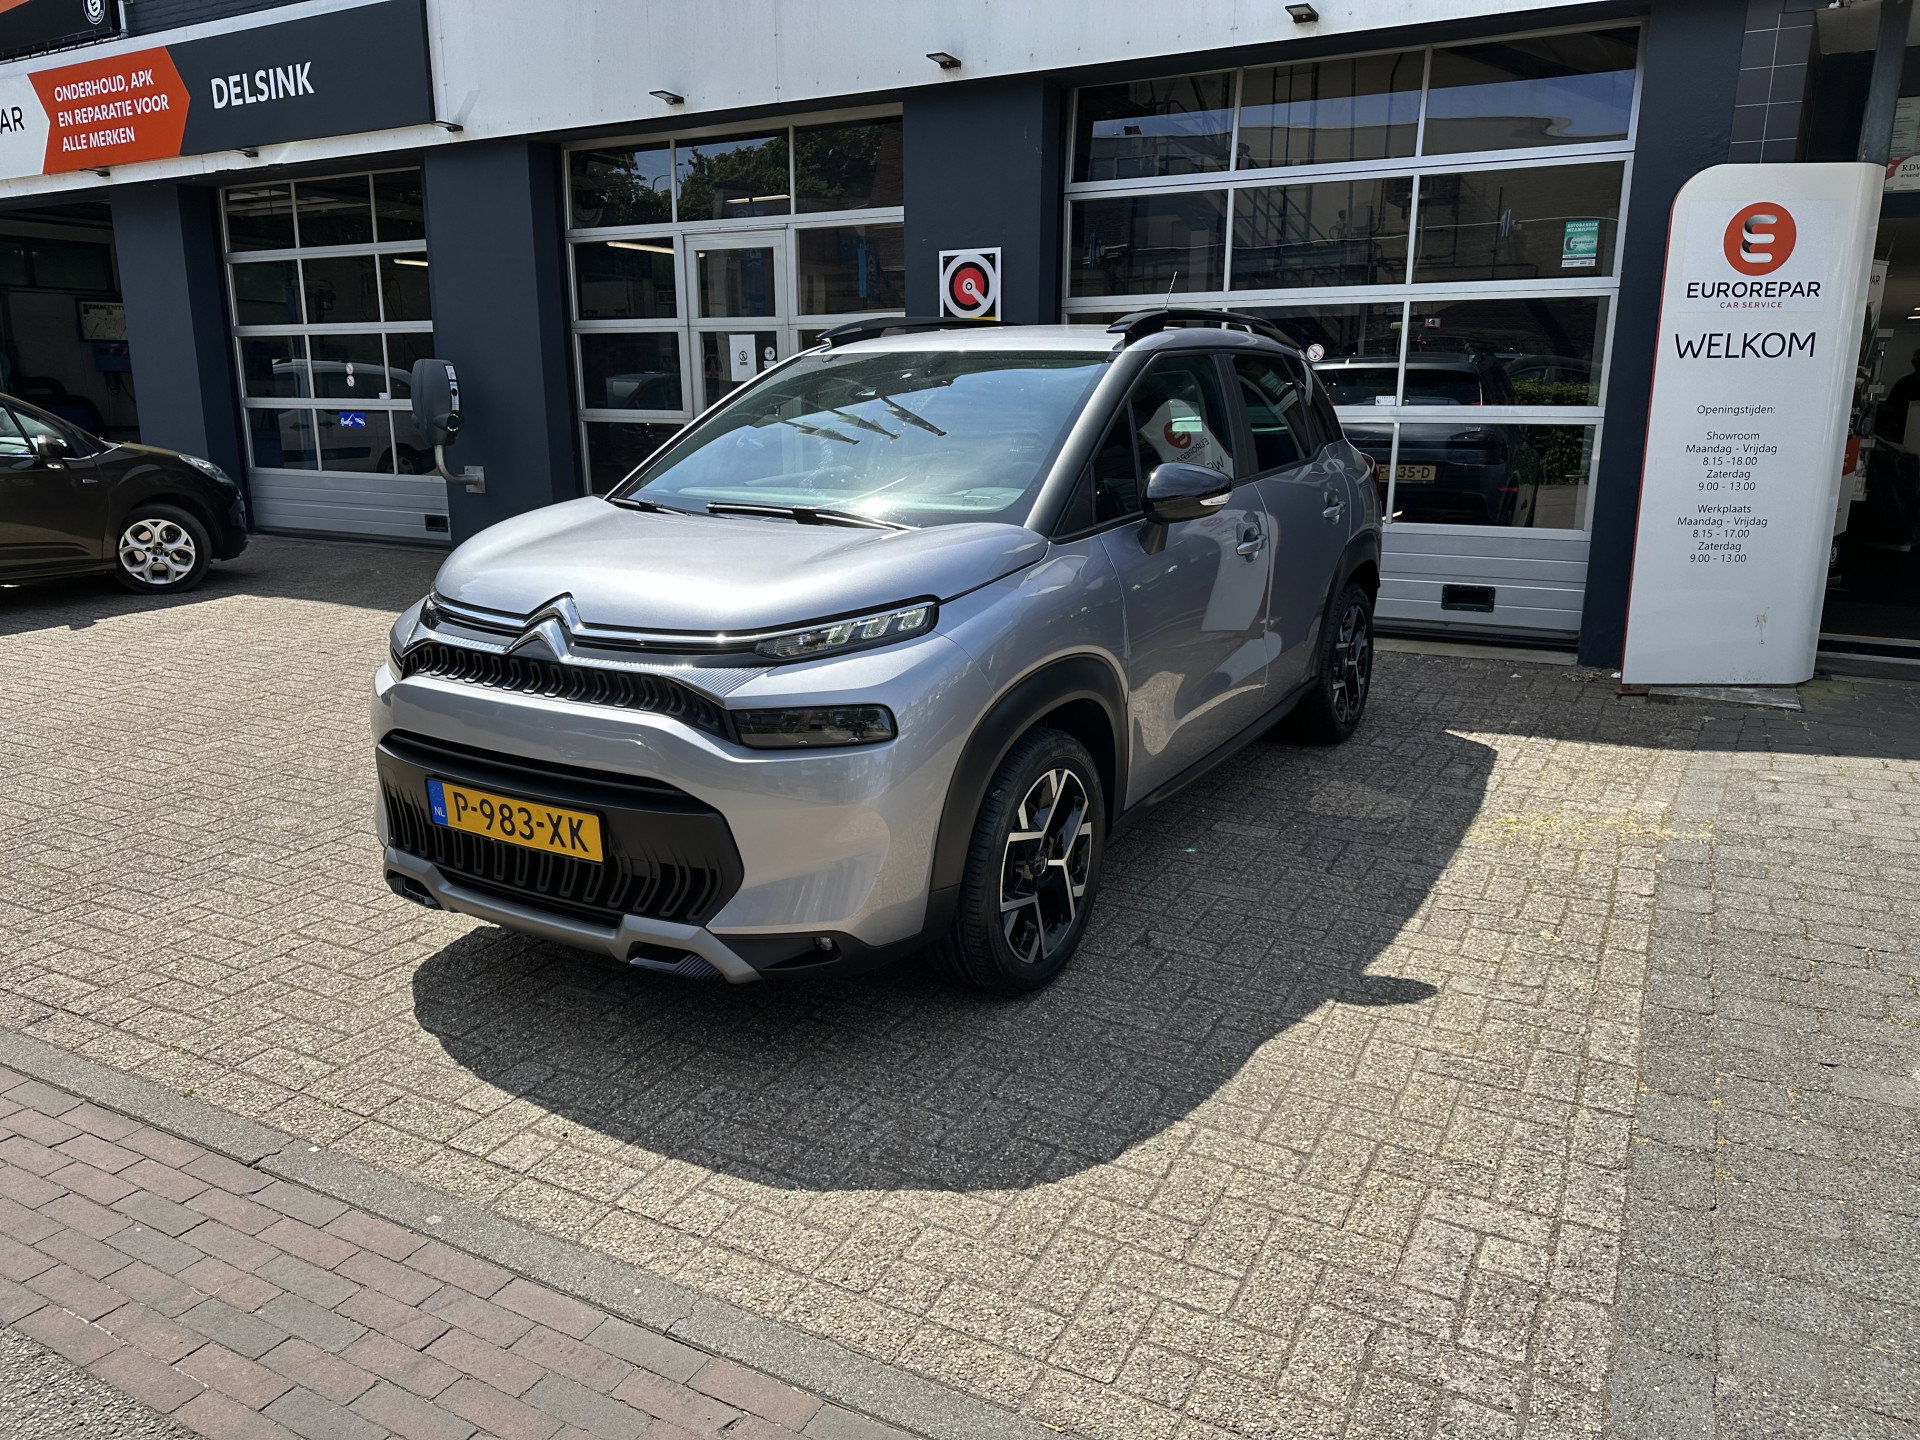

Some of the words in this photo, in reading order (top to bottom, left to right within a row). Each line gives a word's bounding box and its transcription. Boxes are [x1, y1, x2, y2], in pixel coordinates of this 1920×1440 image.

[55, 74, 129, 102] ONDERHOUD,
[130, 70, 154, 88] APK
[211, 62, 314, 108] DELSINK
[58, 110, 73, 127] EN
[75, 101, 134, 125] REPARATIE
[136, 94, 169, 114] VOOR
[62, 133, 88, 152] ALLE
[90, 127, 135, 148] MERKEN
[1687, 282, 1820, 298] EUROREPAR
[1675, 332, 1816, 358] WELKOM
[1697, 405, 1775, 416] Openingstijden:
[1707, 432, 1759, 440] Showroom
[1686, 444, 1731, 455] Maandag
[1743, 444, 1777, 455] Vrijdag
[1703, 457, 1722, 465] 8.15
[1707, 470, 1750, 480] Zaterdag
[1699, 482, 1718, 490] 9.00
[1731, 482, 1755, 490] 13.00
[1698, 504, 1751, 515] Werkplaats
[1678, 517, 1722, 528] Maandag
[1734, 517, 1767, 528] Vrijdag
[1693, 530, 1712, 538] 8.15
[1725, 530, 1749, 538] 17.00
[1698, 542, 1741, 552] Zaterdag
[1690, 554, 1710, 562] 9.00
[1722, 554, 1746, 562] 13.00
[434, 807, 445, 817] NL
[453, 791, 589, 852] P-983-XK
